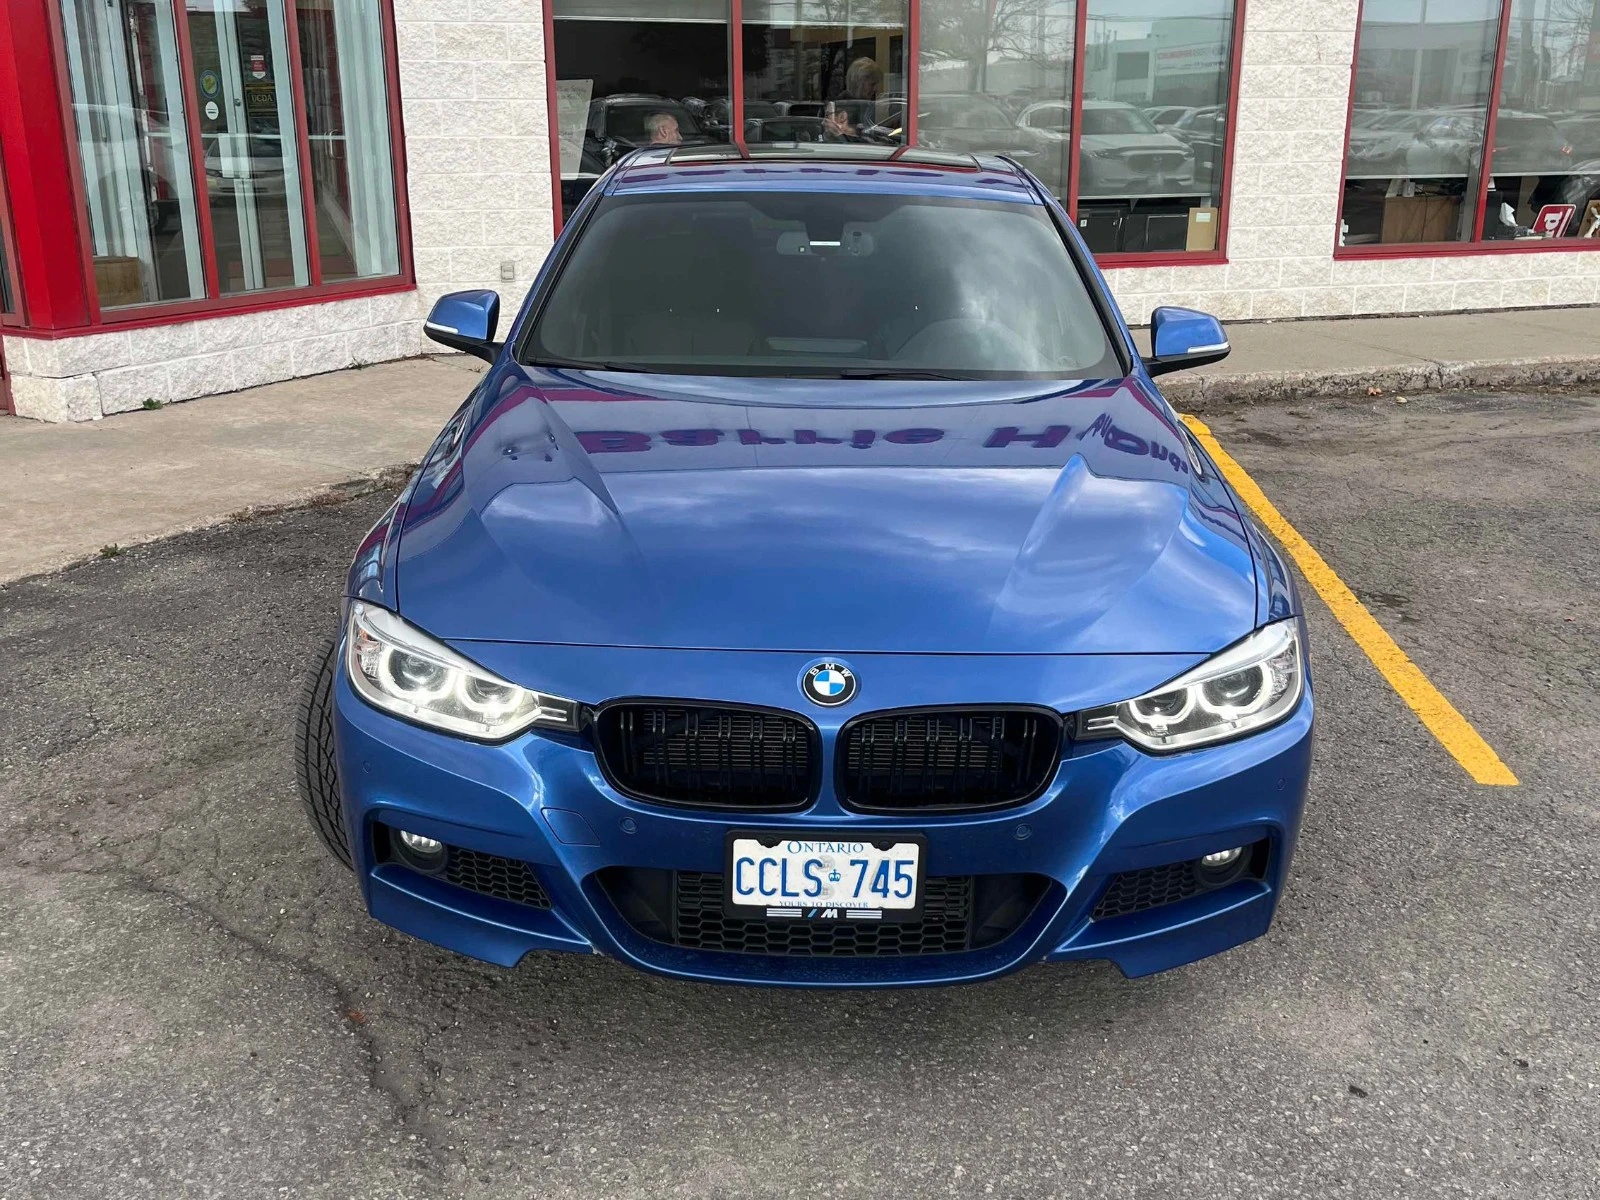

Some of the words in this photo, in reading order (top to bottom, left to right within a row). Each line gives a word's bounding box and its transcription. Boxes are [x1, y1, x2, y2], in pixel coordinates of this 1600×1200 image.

[250, 94, 273, 102] UCDA
[810, 663, 852, 678] BMW
[787, 841, 864, 855] ONTARIO
[736, 857, 823, 897] CCLS
[850, 859, 914, 898] 745
[779, 900, 808, 908] YOURS
[825, 901, 869, 909] DISCOVER
